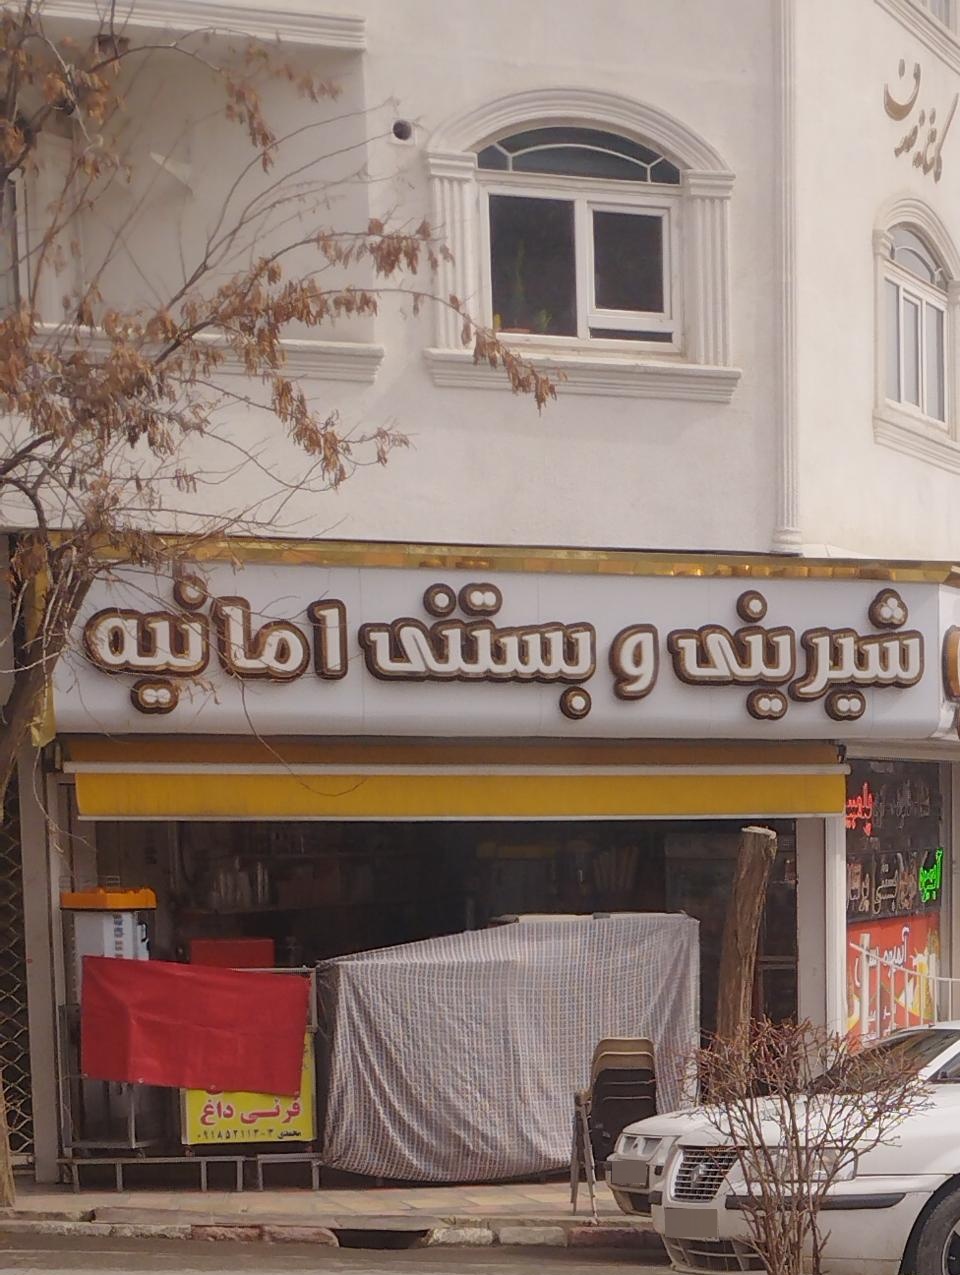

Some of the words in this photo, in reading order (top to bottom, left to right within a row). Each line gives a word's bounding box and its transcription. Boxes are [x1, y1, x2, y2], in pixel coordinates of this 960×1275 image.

[358, 582, 596, 720] بستنی
[609, 623, 660, 701] و
[668, 588, 925, 721] شیرینی
[200, 1099, 235, 1126] داغ
